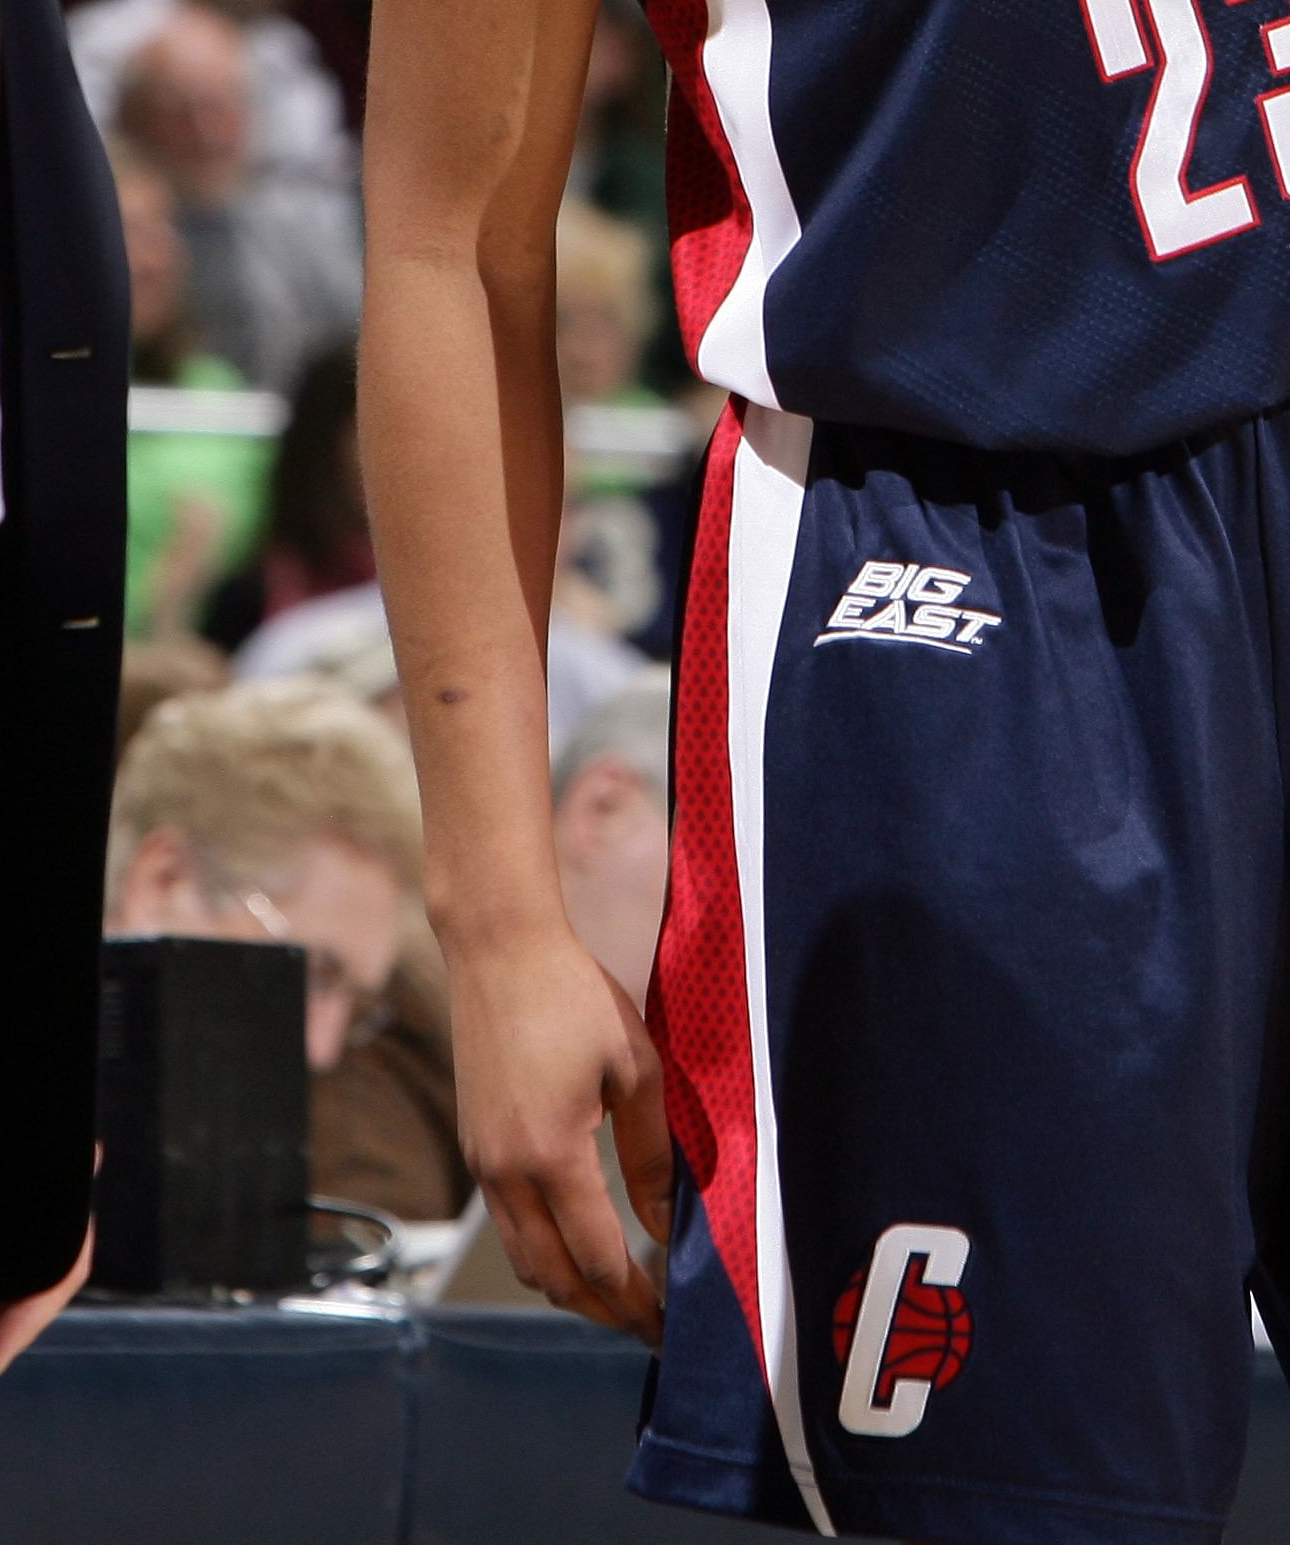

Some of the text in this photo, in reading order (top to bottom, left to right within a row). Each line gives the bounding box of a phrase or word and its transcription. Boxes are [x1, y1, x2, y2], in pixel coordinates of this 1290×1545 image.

[846, 560, 972, 605] BIG
[825, 594, 1003, 645] EAST
[838, 1223, 970, 1438] C
